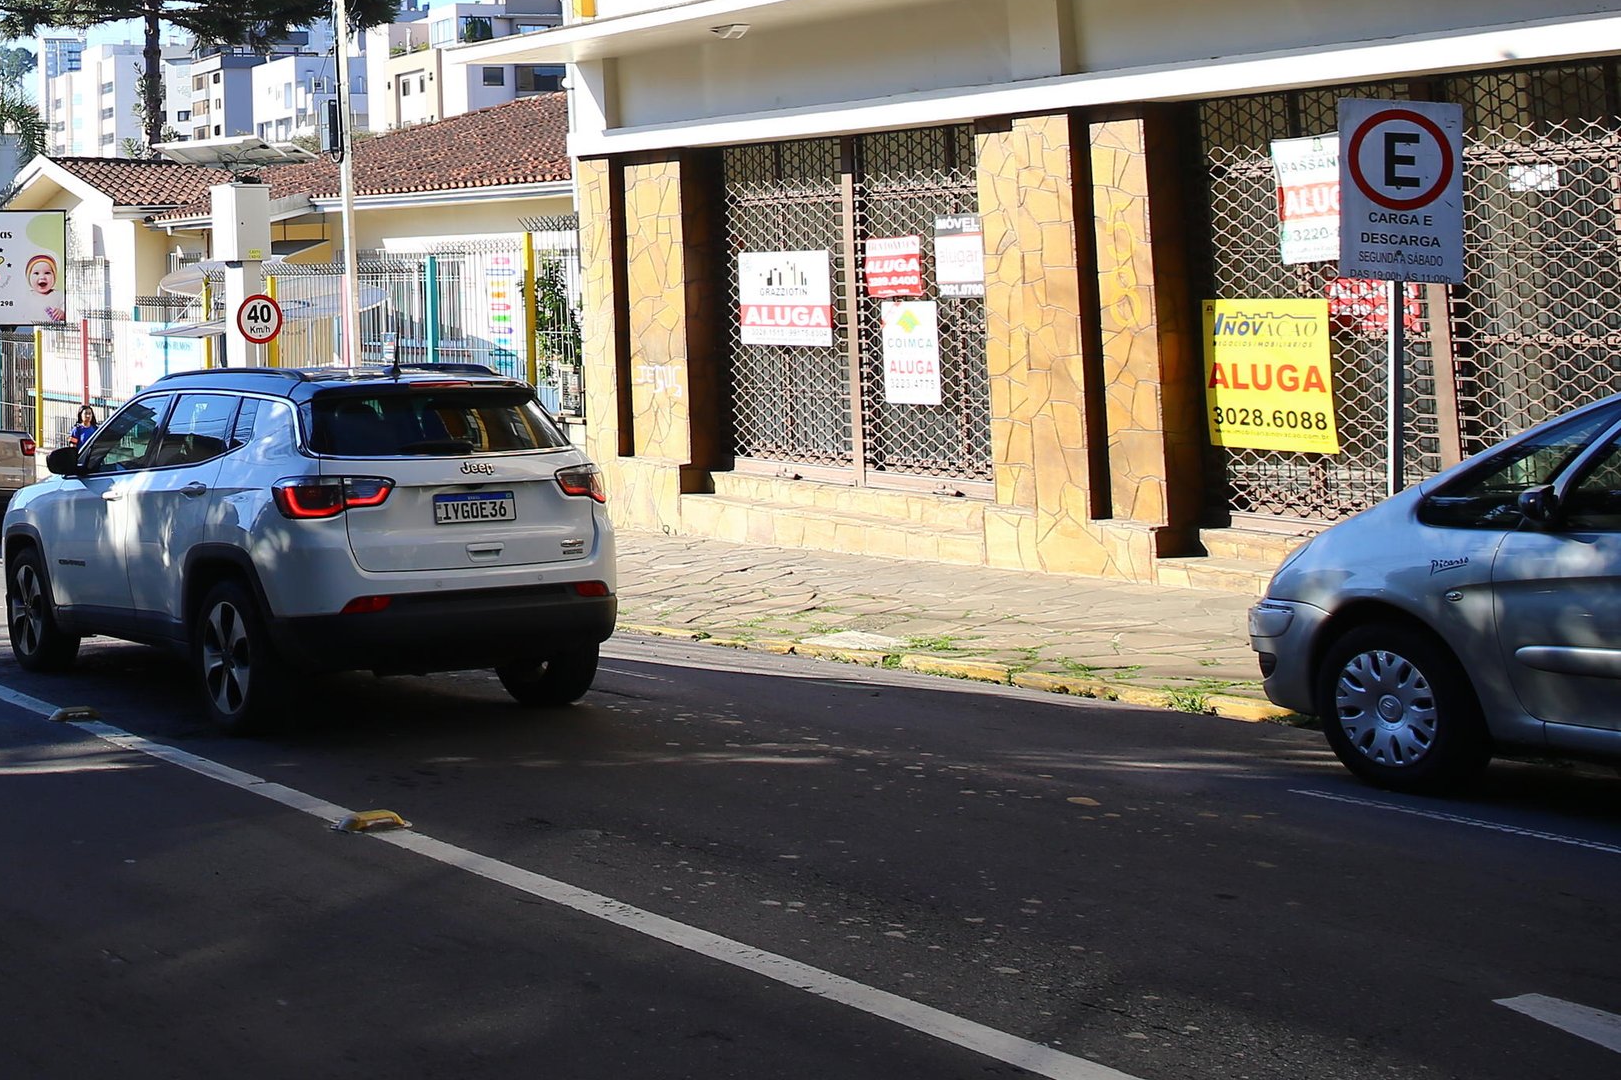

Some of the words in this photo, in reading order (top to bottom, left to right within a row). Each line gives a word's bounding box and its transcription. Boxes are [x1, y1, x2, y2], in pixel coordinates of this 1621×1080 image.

[1384, 132, 1421, 188] E
[1369, 212, 1420, 226] CARGA
[1424, 215, 1433, 226] E
[1361, 232, 1441, 248] DESCARGA
[867, 258, 919, 273] ALUGA
[1358, 250, 1399, 265] SEGUNDA
[1408, 252, 1444, 267] SÁBADO
[1350, 269, 1370, 278] DAS
[1373, 271, 1402, 280] 19:00h
[1421, 274, 1452, 283] 11:00h
[760, 287, 808, 296] GRAZZIOTIN
[247, 304, 271, 324] 40
[744, 306, 829, 326] ALUGA
[250, 326, 271, 334] Km/h
[888, 338, 933, 348] COIMCA
[889, 360, 934, 375] ALUGA
[1208, 362, 1327, 393] ALUGA
[1214, 406, 1328, 430] 3028.6088
[461, 461, 495, 475] Jeep
[1429, 556, 1469, 577] Picasso
